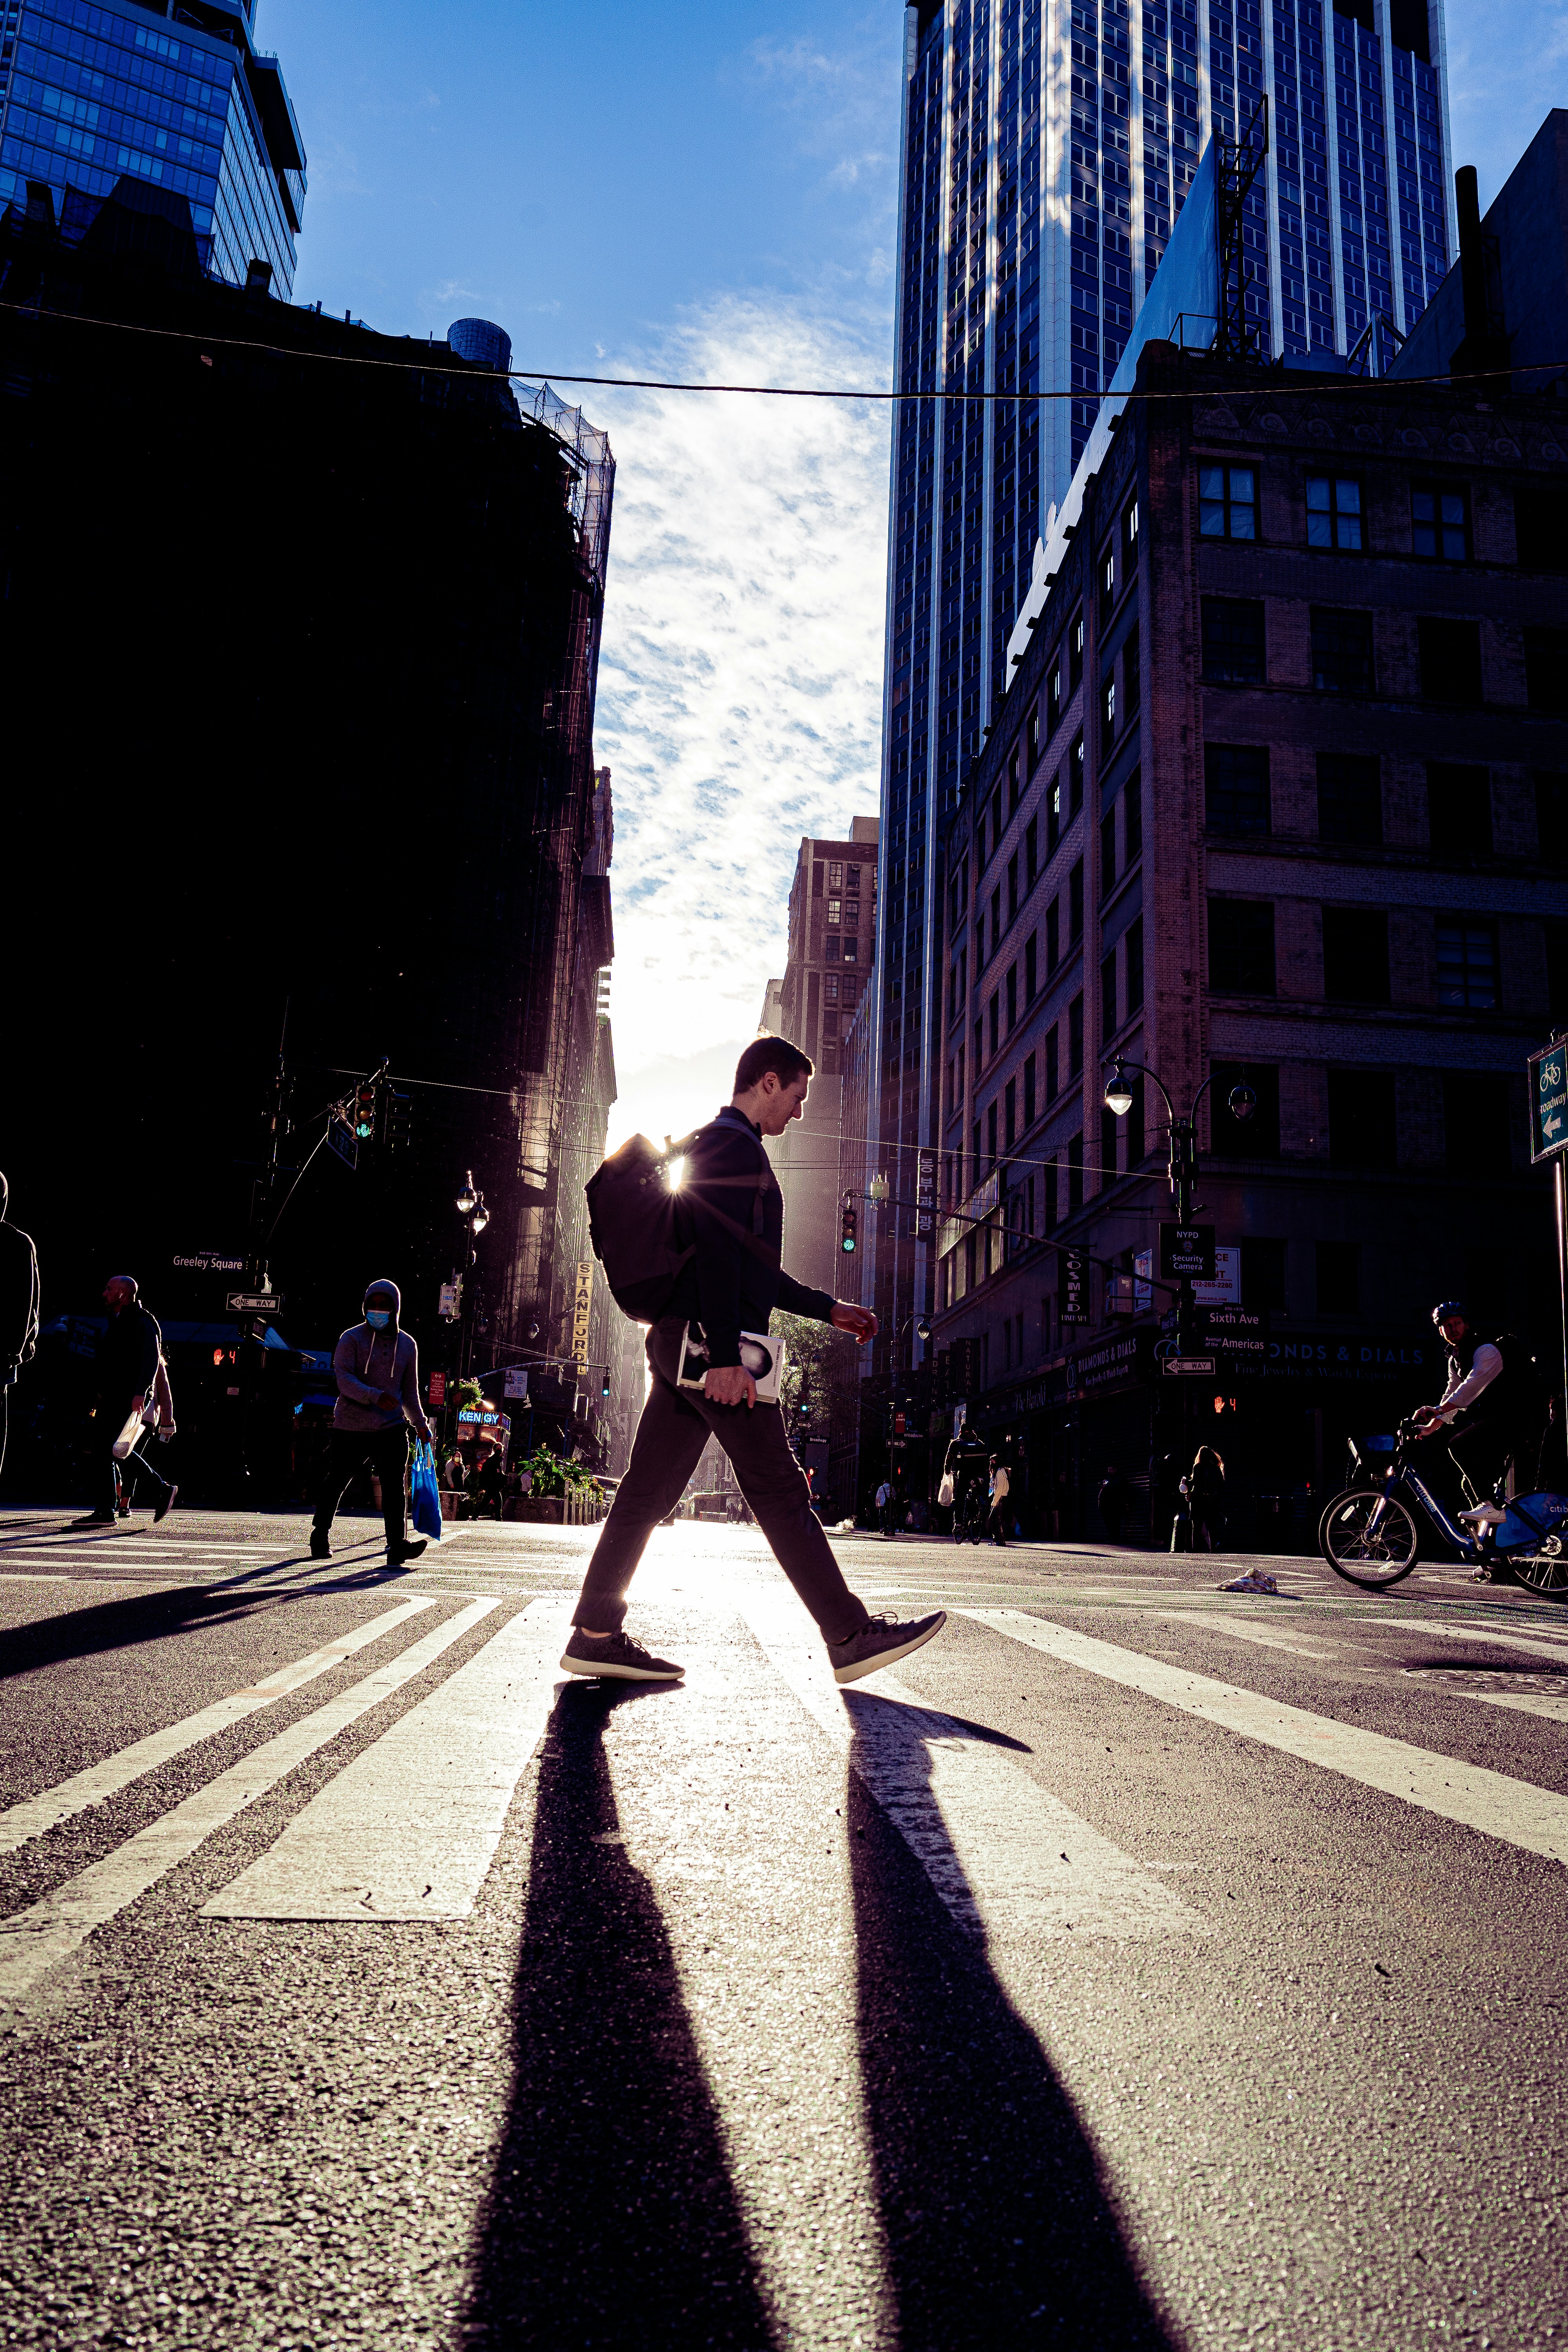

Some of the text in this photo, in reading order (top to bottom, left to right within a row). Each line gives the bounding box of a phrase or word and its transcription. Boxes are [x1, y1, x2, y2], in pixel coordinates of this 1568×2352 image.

[1538, 1092, 1566, 1115] Broadway
[173, 1256, 242, 1270] Greeley Square
[1138, 1257, 1149, 1269] SPACE
[1172, 1255, 1203, 1263] Security
[573, 1263, 591, 1362] STANFORD
[1210, 1312, 1259, 1324] Sixth Ave
[1222, 1338, 1264, 1350] Americas
[229, 1351, 235, 1364] 4
[1078, 1338, 1136, 1373] DIAMONDS & DIALS
[1337, 1346, 1350, 1361] &
[1360, 1347, 1423, 1364] DIALS
[1093, 1373, 1103, 1387] Jewelry
[1103, 1371, 1106, 1380] &
[1107, 1368, 1116, 1379] Watch
[1116, 1365, 1129, 1377] Experts
[1235, 1363, 1396, 1383] Fine Jewelry & Watch Experts
[1014, 1392, 1025, 1414] The
[1026, 1383, 1045, 1409] Harold
[1230, 1398, 1236, 1411] 4
[459, 1412, 481, 1423] KEN
[483, 1413, 499, 1423] GY
